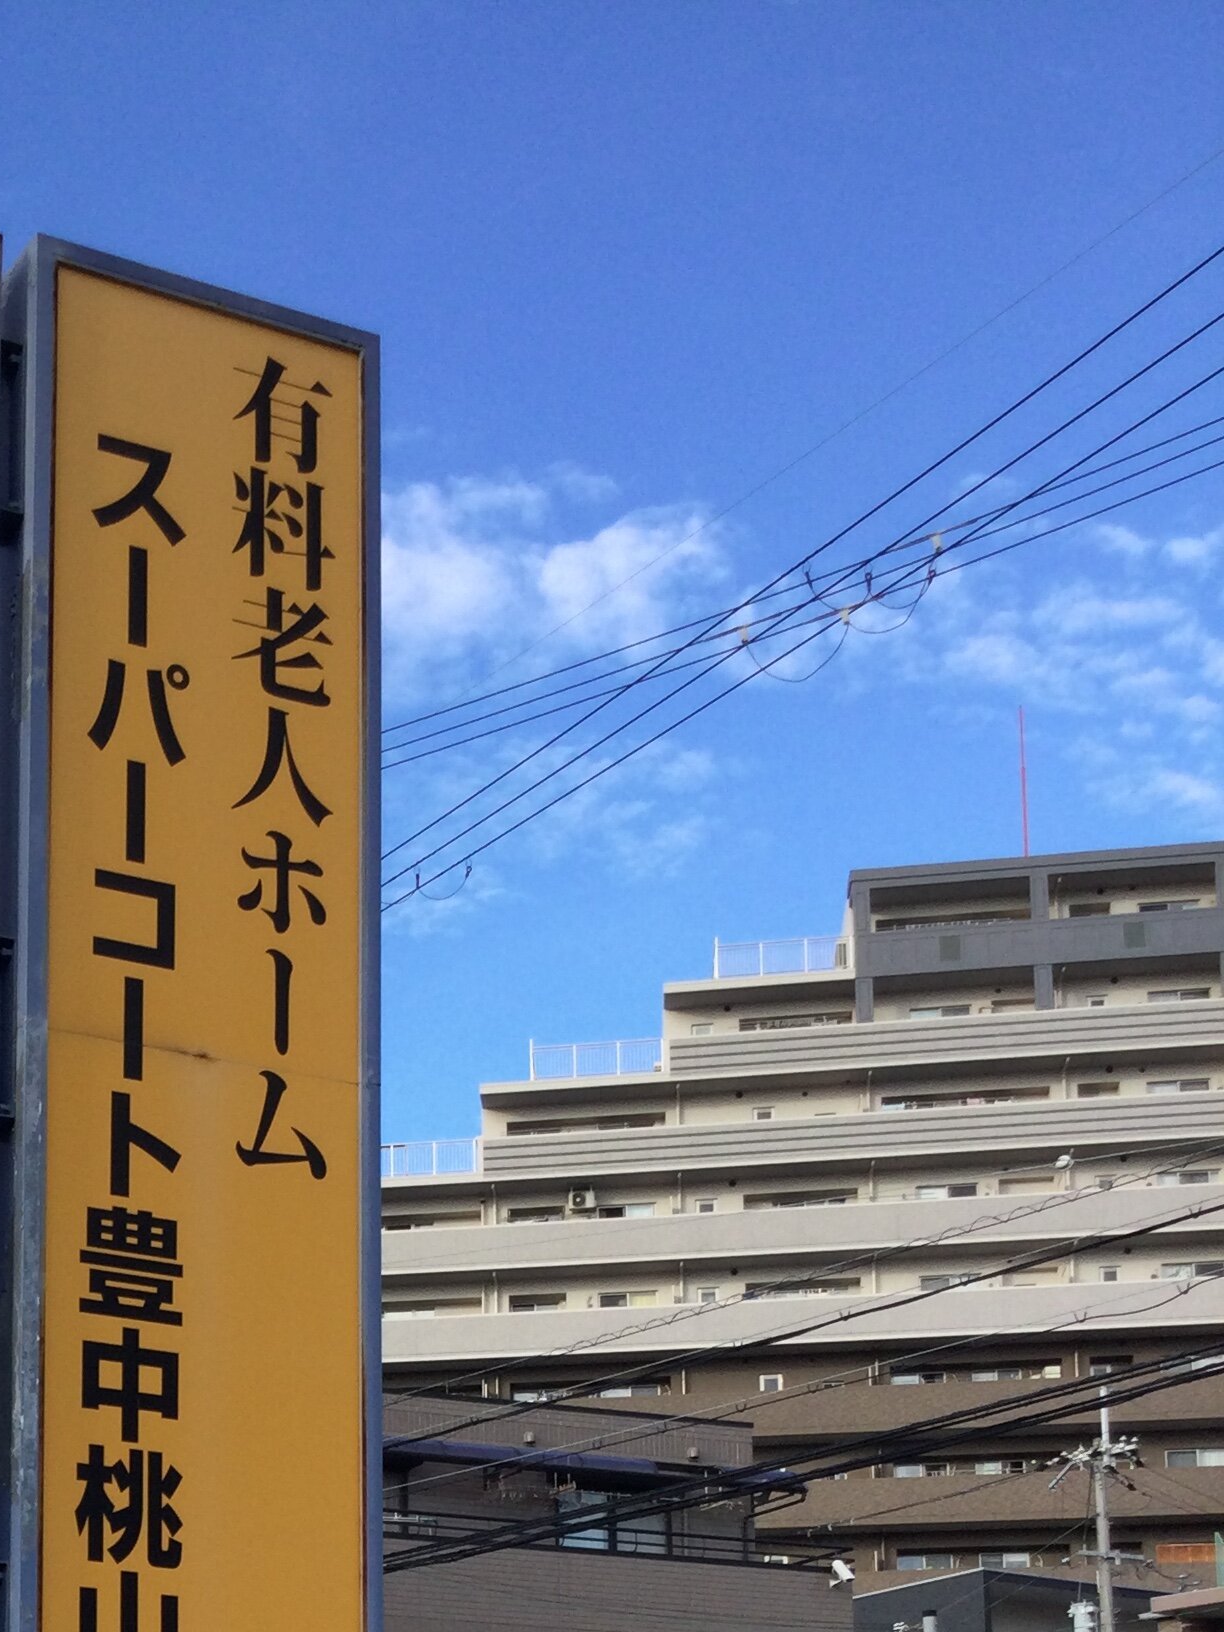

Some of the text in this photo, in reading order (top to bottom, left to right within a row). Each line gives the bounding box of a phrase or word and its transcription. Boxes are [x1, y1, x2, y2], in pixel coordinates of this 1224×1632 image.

[232, 356, 336, 1180] 有料老人ホーム
